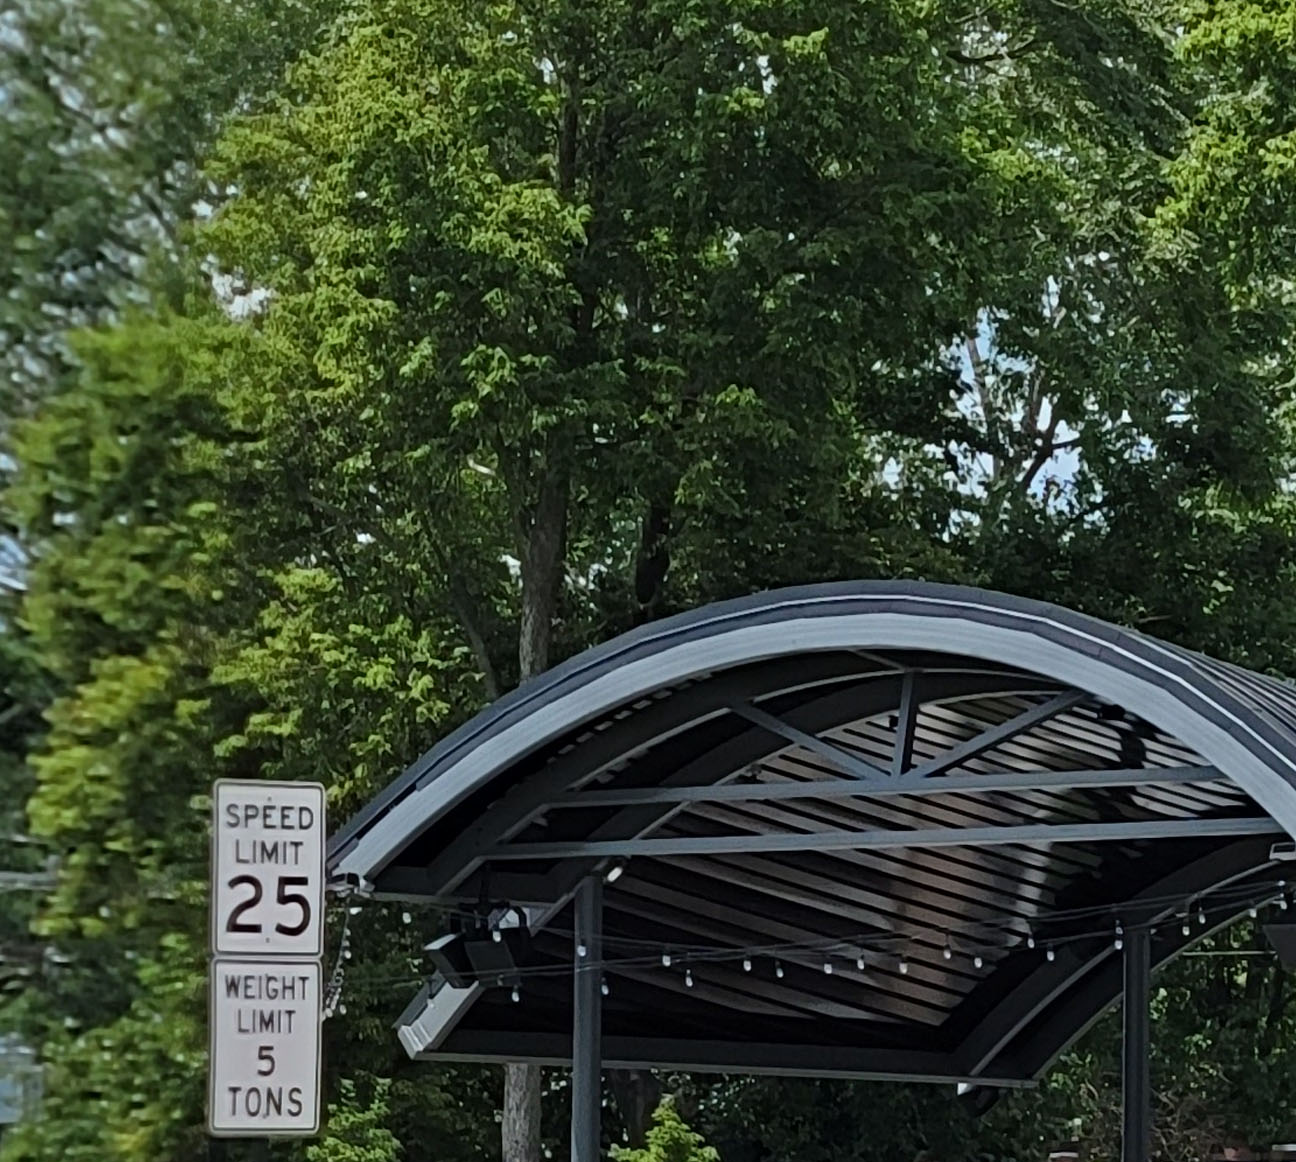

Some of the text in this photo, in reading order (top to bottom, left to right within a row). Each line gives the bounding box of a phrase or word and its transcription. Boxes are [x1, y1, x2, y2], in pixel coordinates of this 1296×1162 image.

[226, 804, 314, 830] SPEED
[235, 840, 304, 865] LIMIT
[226, 875, 311, 937] 25
[225, 975, 310, 1000] WEIGHT
[238, 1009, 296, 1034] LIMIT
[257, 1046, 275, 1077] 5
[228, 1086, 302, 1117] TONS
